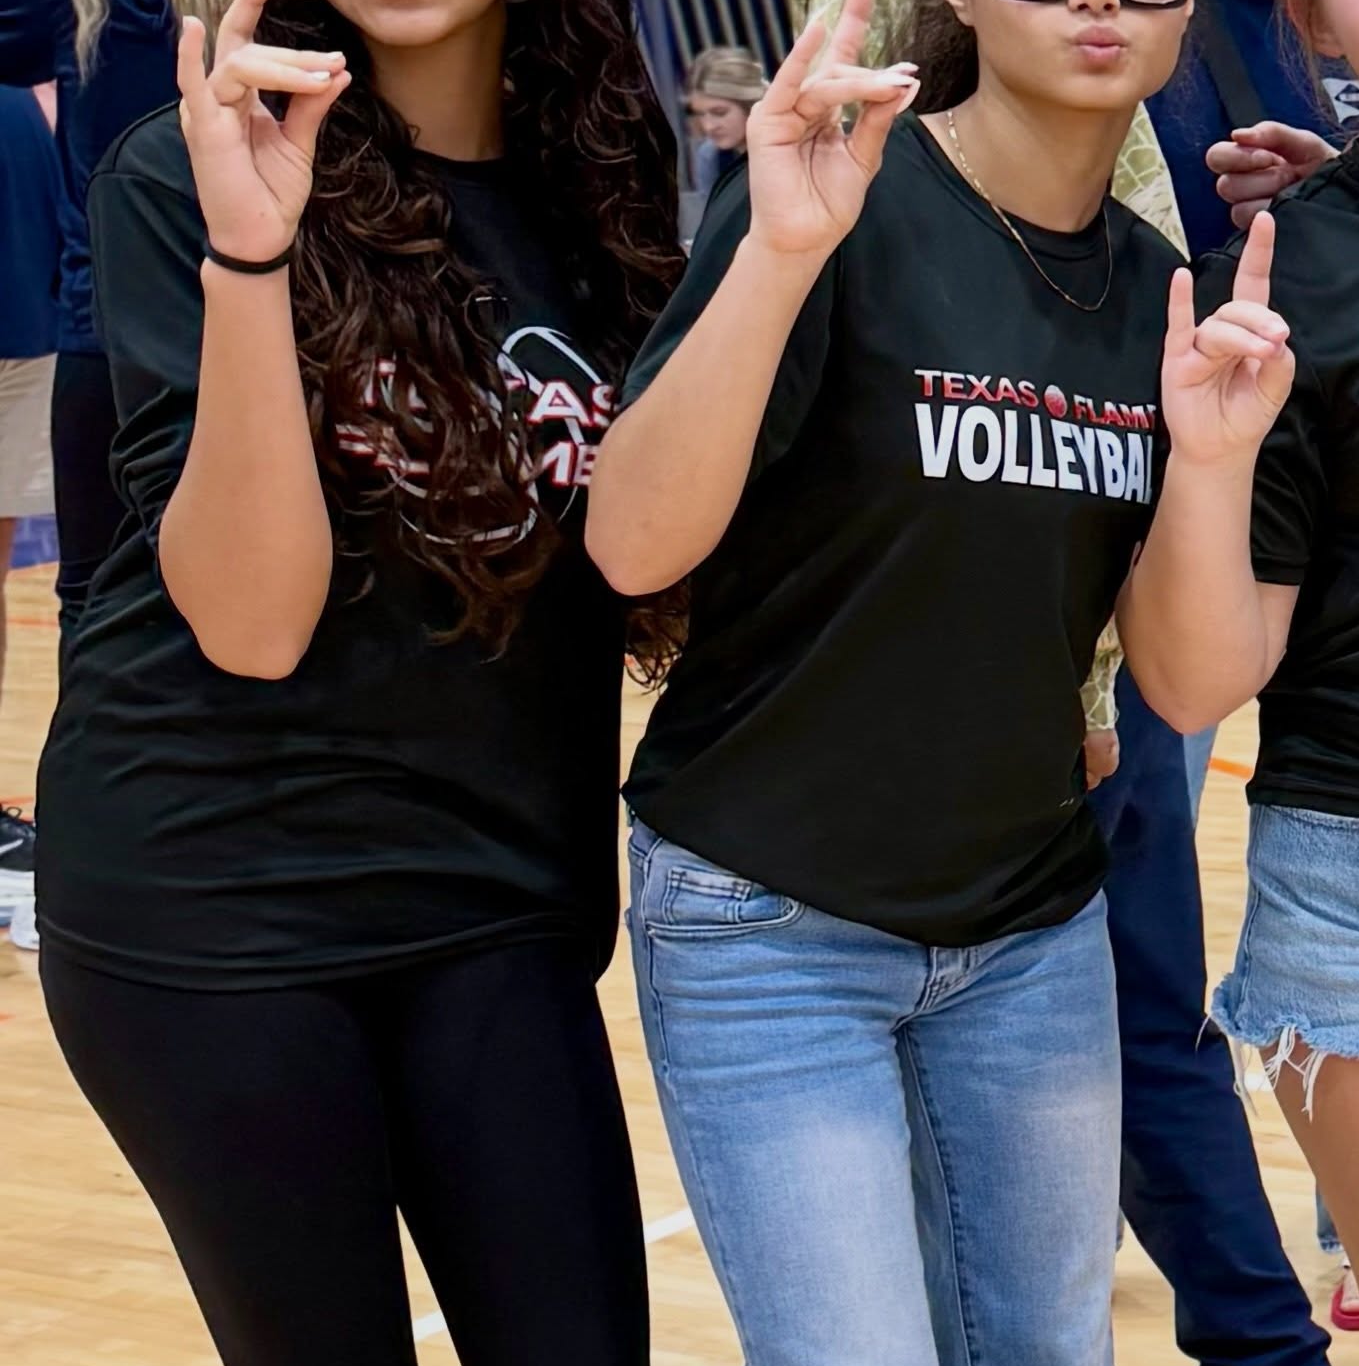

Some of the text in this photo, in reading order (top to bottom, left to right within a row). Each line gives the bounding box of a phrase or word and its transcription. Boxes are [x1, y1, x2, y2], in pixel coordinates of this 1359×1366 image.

[914, 369, 1157, 430] TEXAS FLAM
[914, 403, 1153, 505] VOLLEYBA
